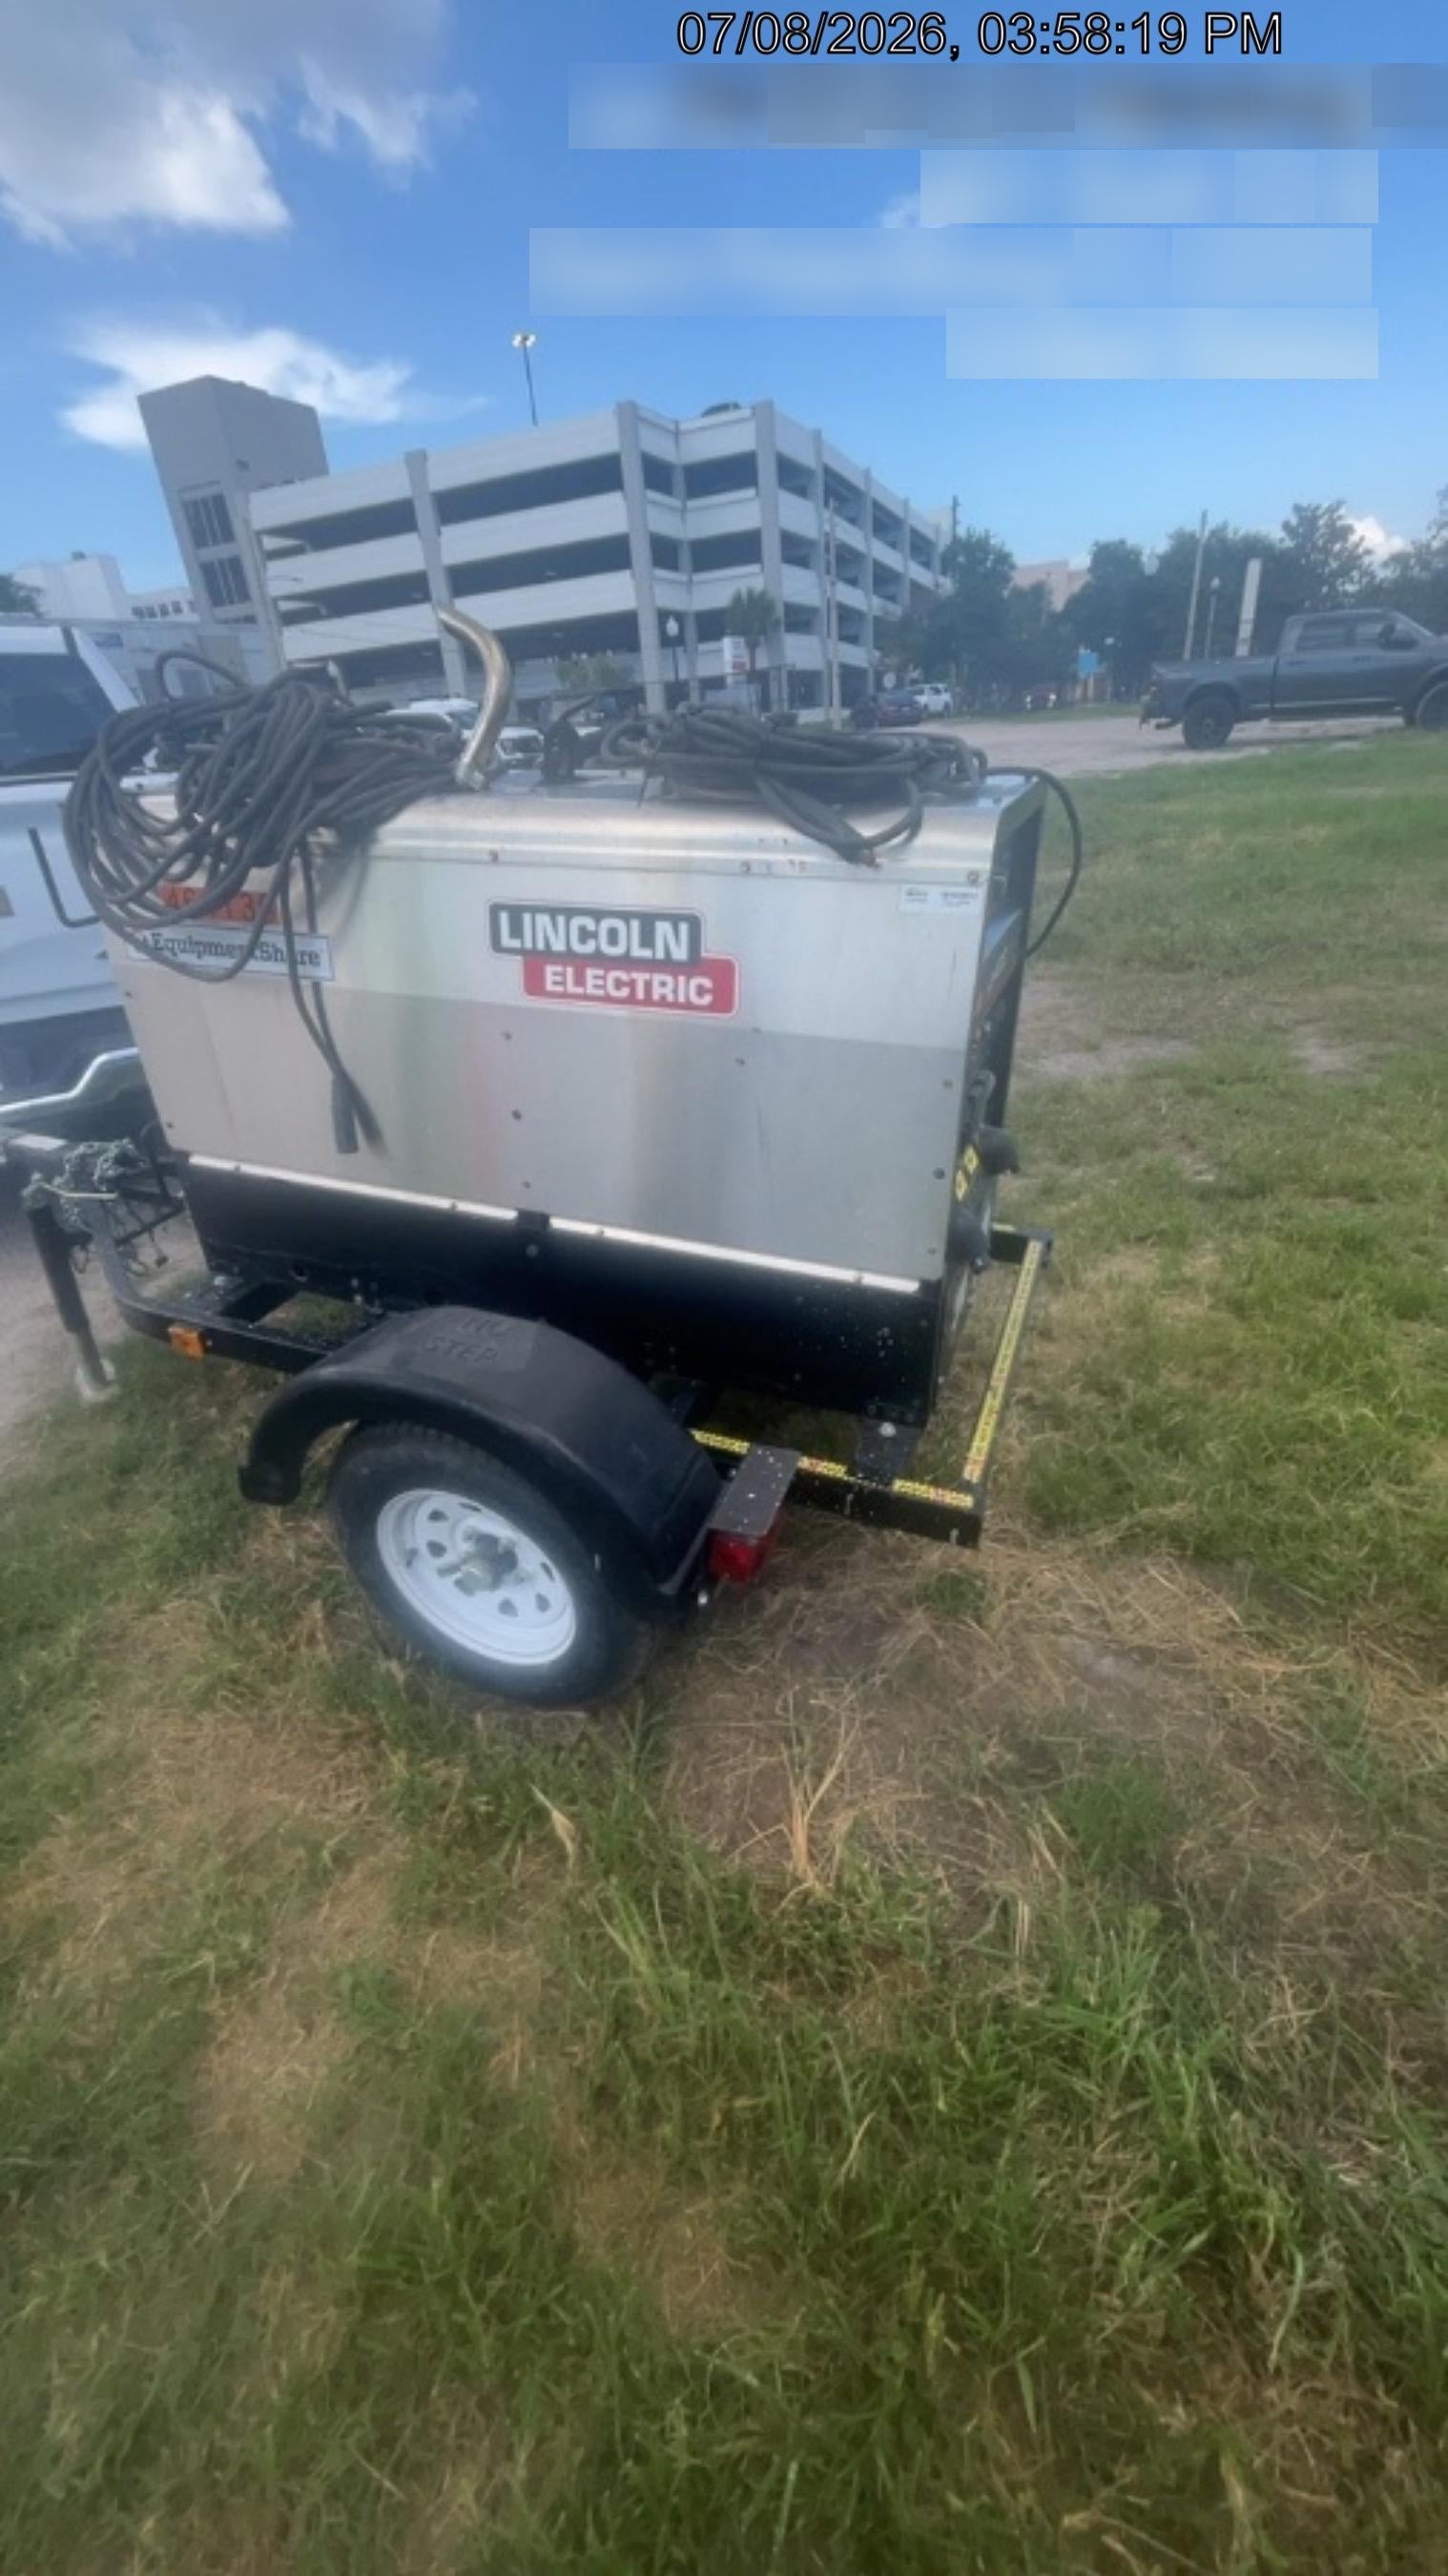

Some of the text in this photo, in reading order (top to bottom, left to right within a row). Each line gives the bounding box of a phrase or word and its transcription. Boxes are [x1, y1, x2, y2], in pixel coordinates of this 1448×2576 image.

[499, 909, 690, 963] LINCOLN
[544, 964, 714, 1007] ELECTRIC
[424, 1336, 500, 1363] STEP
